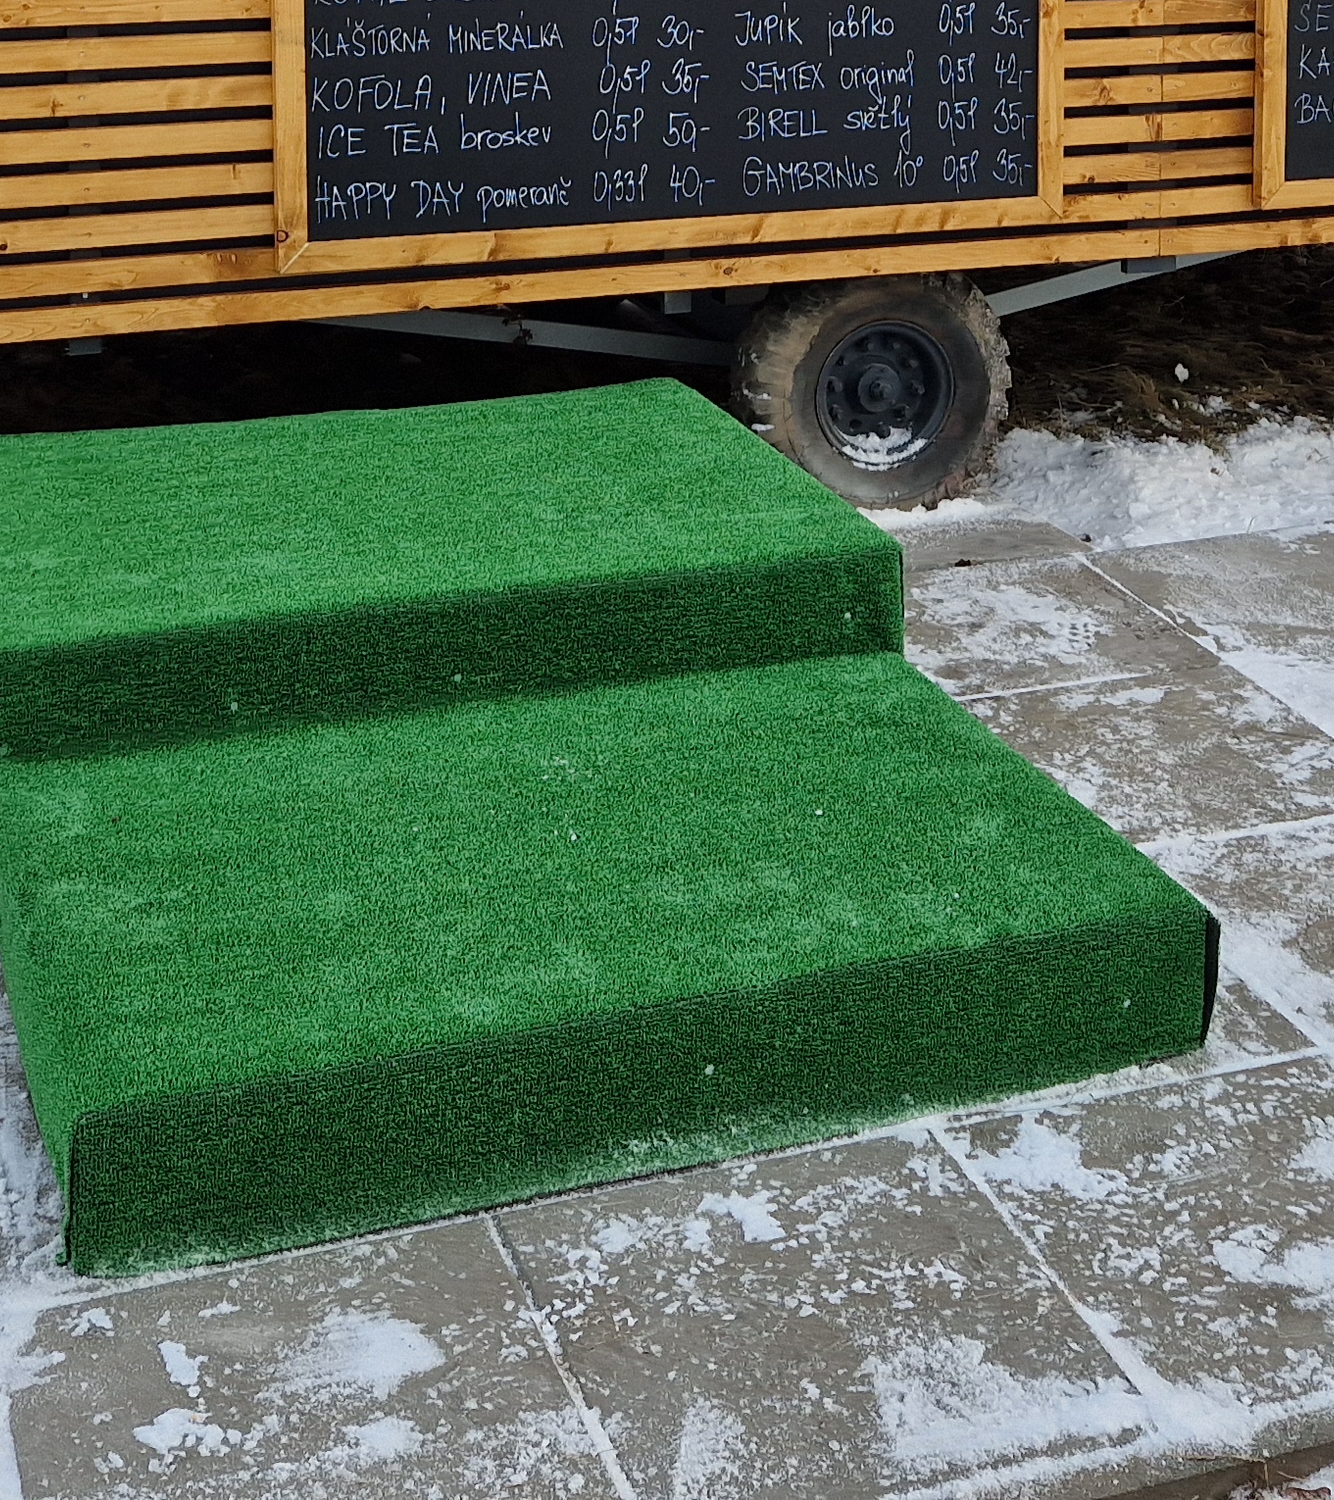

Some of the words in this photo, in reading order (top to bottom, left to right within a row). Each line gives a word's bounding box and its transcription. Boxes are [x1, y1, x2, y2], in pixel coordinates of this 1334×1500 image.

[310, 12, 431, 59] KLÁŠTORNÁ
[448, 11, 565, 54] MINERÁLKA
[656, 15, 705, 52] 30,-
[735, 1, 803, 46] JUPÍK
[827, 4, 895, 56] jablko
[991, 1, 1031, 38] 35,-
[311, 74, 445, 115] KOFOLA,
[467, 69, 553, 104] VINEA
[661, 58, 710, 103] 35,-
[740, 61, 826, 94] SEMTEX
[840, 49, 916, 105] original
[995, 52, 1033, 93] 42,-
[318, 124, 366, 159] ICE
[384, 123, 440, 157] TEA
[460, 113, 552, 150] broskev
[737, 106, 828, 141] BIRELL
[843, 94, 912, 155] světlý
[993, 98, 1035, 140] 35,-
[314, 175, 397, 223] HAPPY
[410, 181, 464, 218] DAY
[476, 178, 572, 223] pomeranč
[669, 164, 716, 205] 40,-
[742, 155, 879, 196] GAMBRINUS
[992, 149, 1033, 186] 35,-
